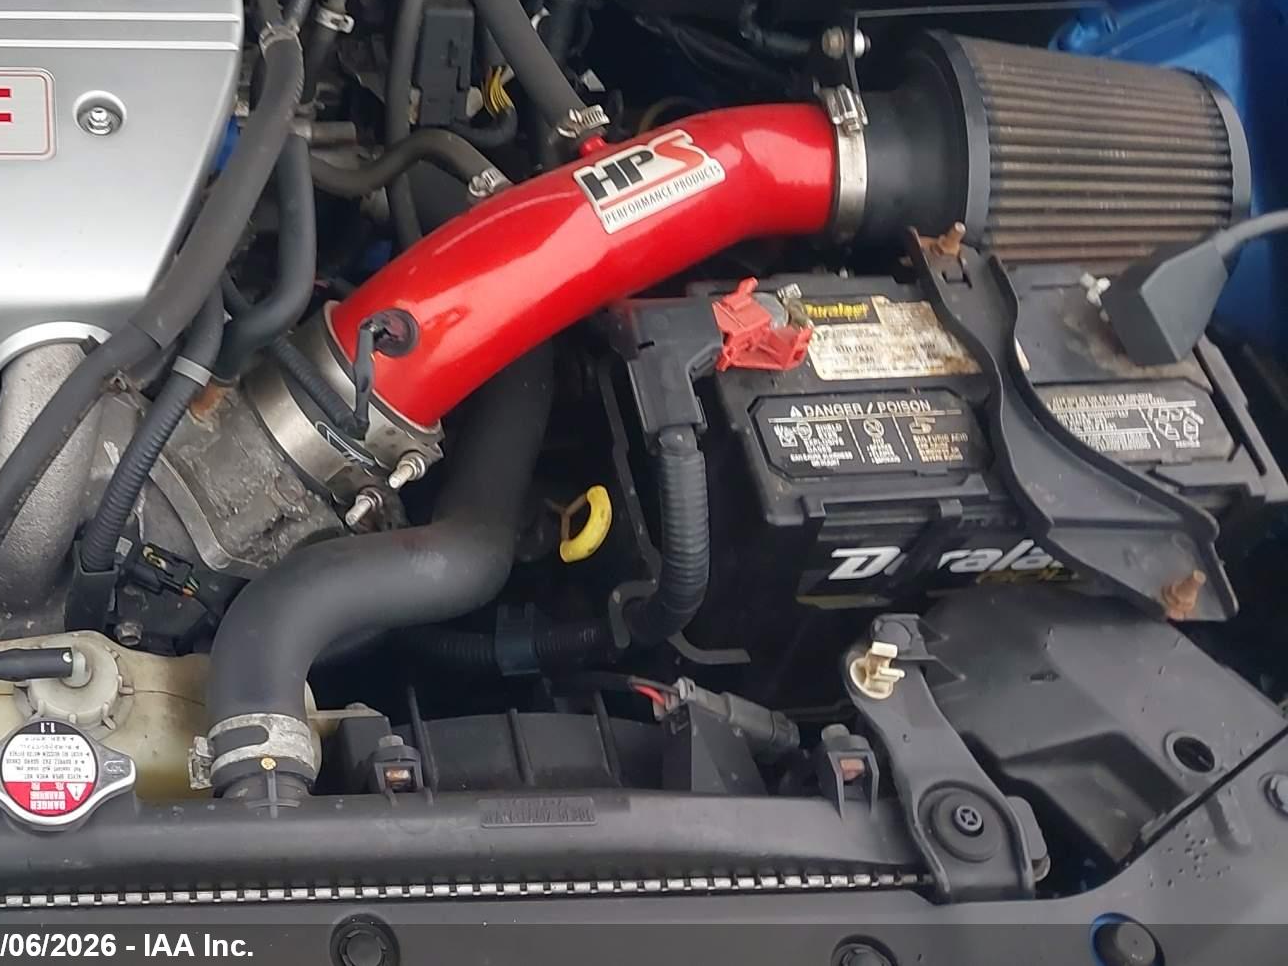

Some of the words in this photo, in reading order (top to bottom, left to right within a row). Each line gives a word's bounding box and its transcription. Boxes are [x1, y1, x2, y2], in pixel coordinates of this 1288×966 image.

[580, 133, 705, 201] HPS
[604, 186, 672, 225] PERFORMANCE
[673, 164, 722, 194] PRODUCTS
[803, 402, 863, 417] DANGER
[876, 399, 931, 413] POISON
[30, 800, 66, 810] DANGER
